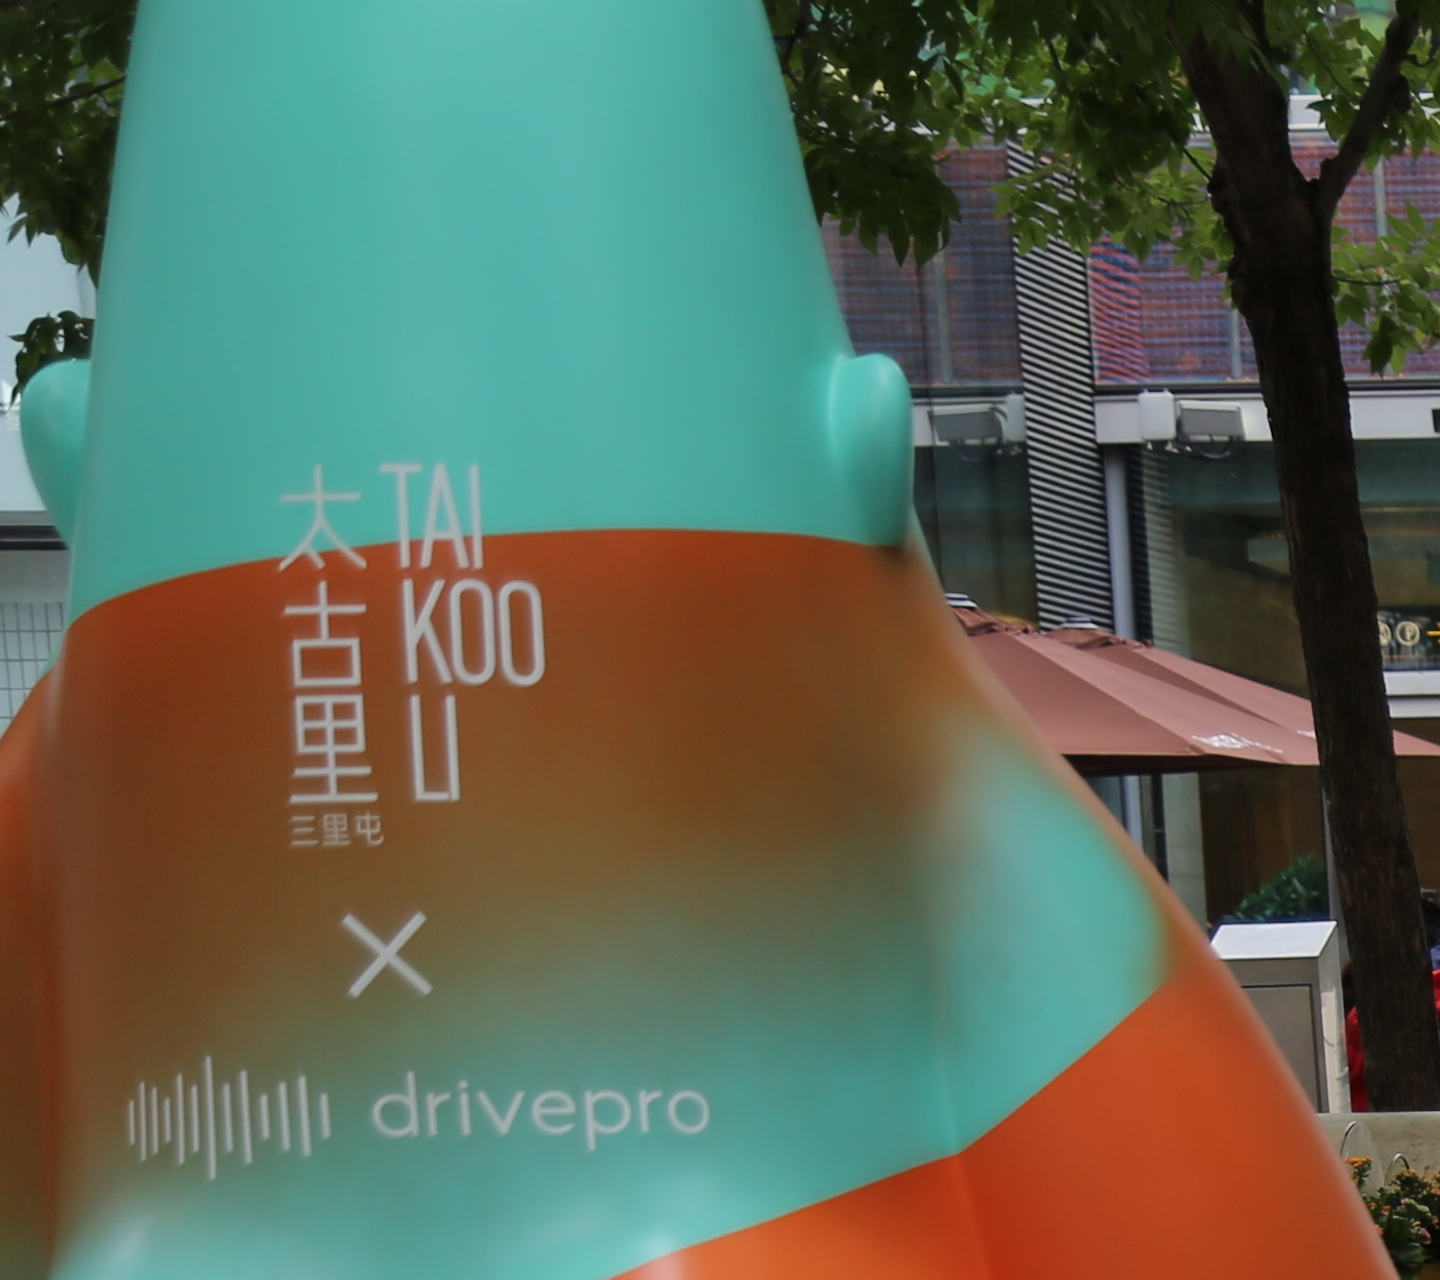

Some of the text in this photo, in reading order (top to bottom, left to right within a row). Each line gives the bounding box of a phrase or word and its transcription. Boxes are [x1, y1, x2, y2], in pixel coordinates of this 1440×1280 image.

[379, 462, 484, 570] TAI
[278, 463, 379, 804] 太古里
[402, 578, 547, 687] KOO
[410, 695, 461, 802] LI
[289, 811, 385, 848] 三里屯
[370, 1070, 712, 1152] drivepro
